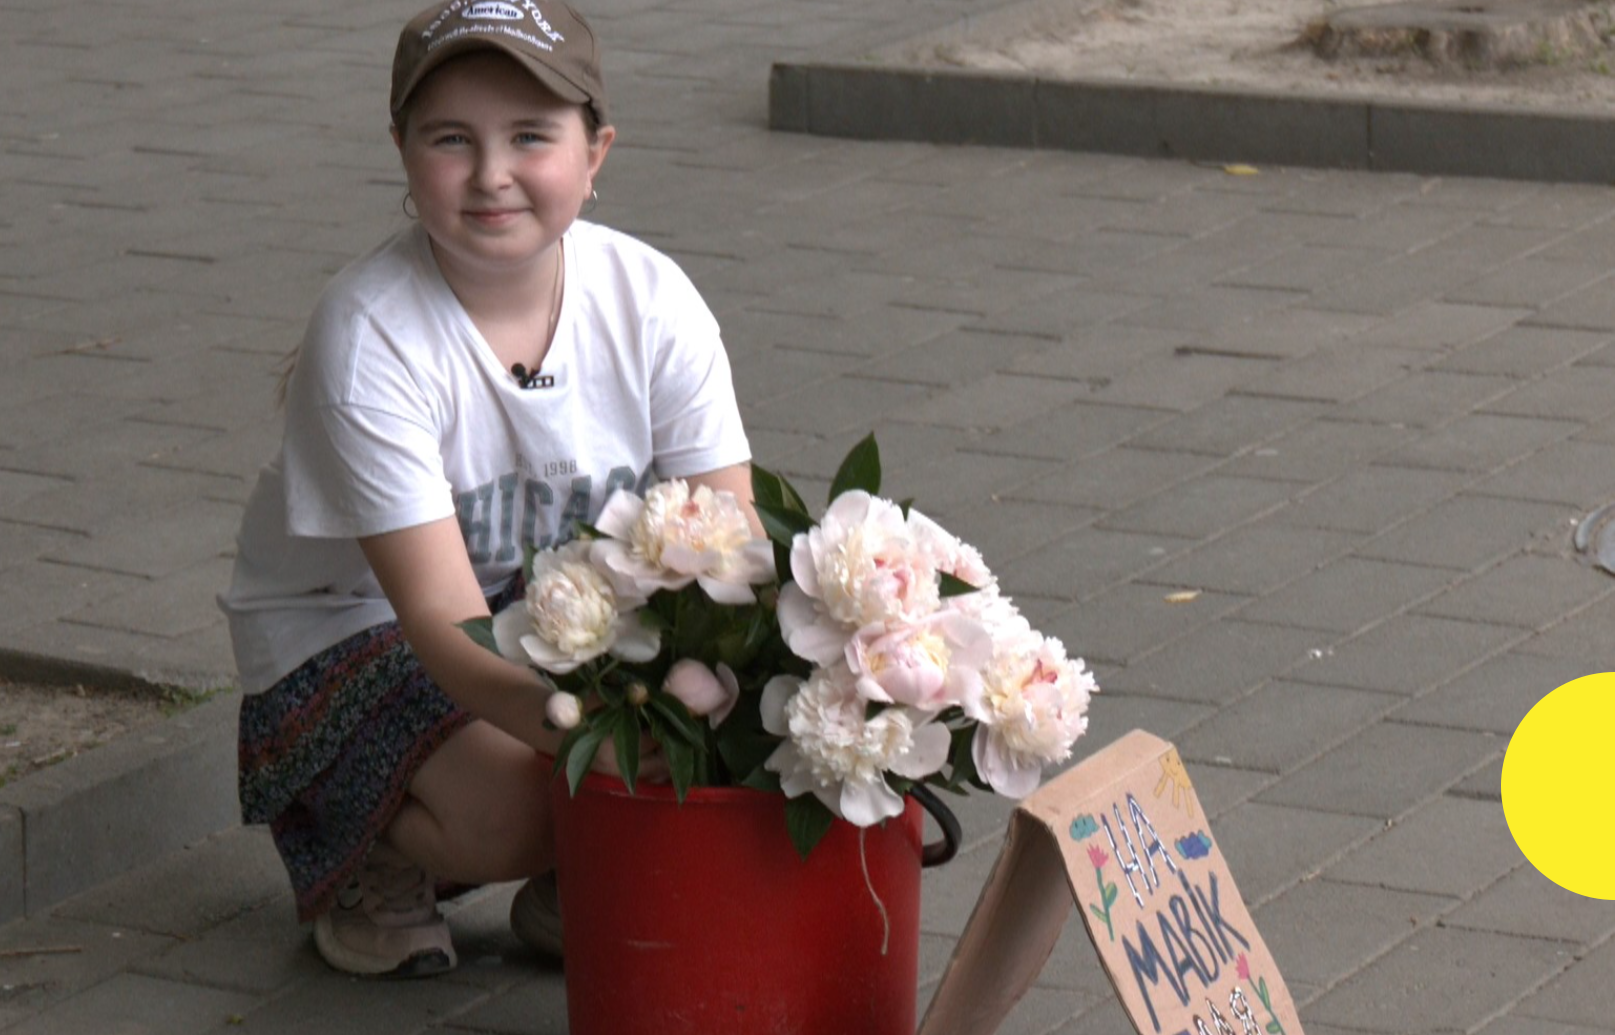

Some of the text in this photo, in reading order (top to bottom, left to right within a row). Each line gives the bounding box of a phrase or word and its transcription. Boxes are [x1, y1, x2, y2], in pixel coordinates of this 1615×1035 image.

[466, 5, 518, 17] American
[457, 465, 655, 564] HICA
[543, 459, 578, 478] 1998
[1100, 792, 1177, 910] НА
[1121, 868, 1250, 1033] МАВІК
